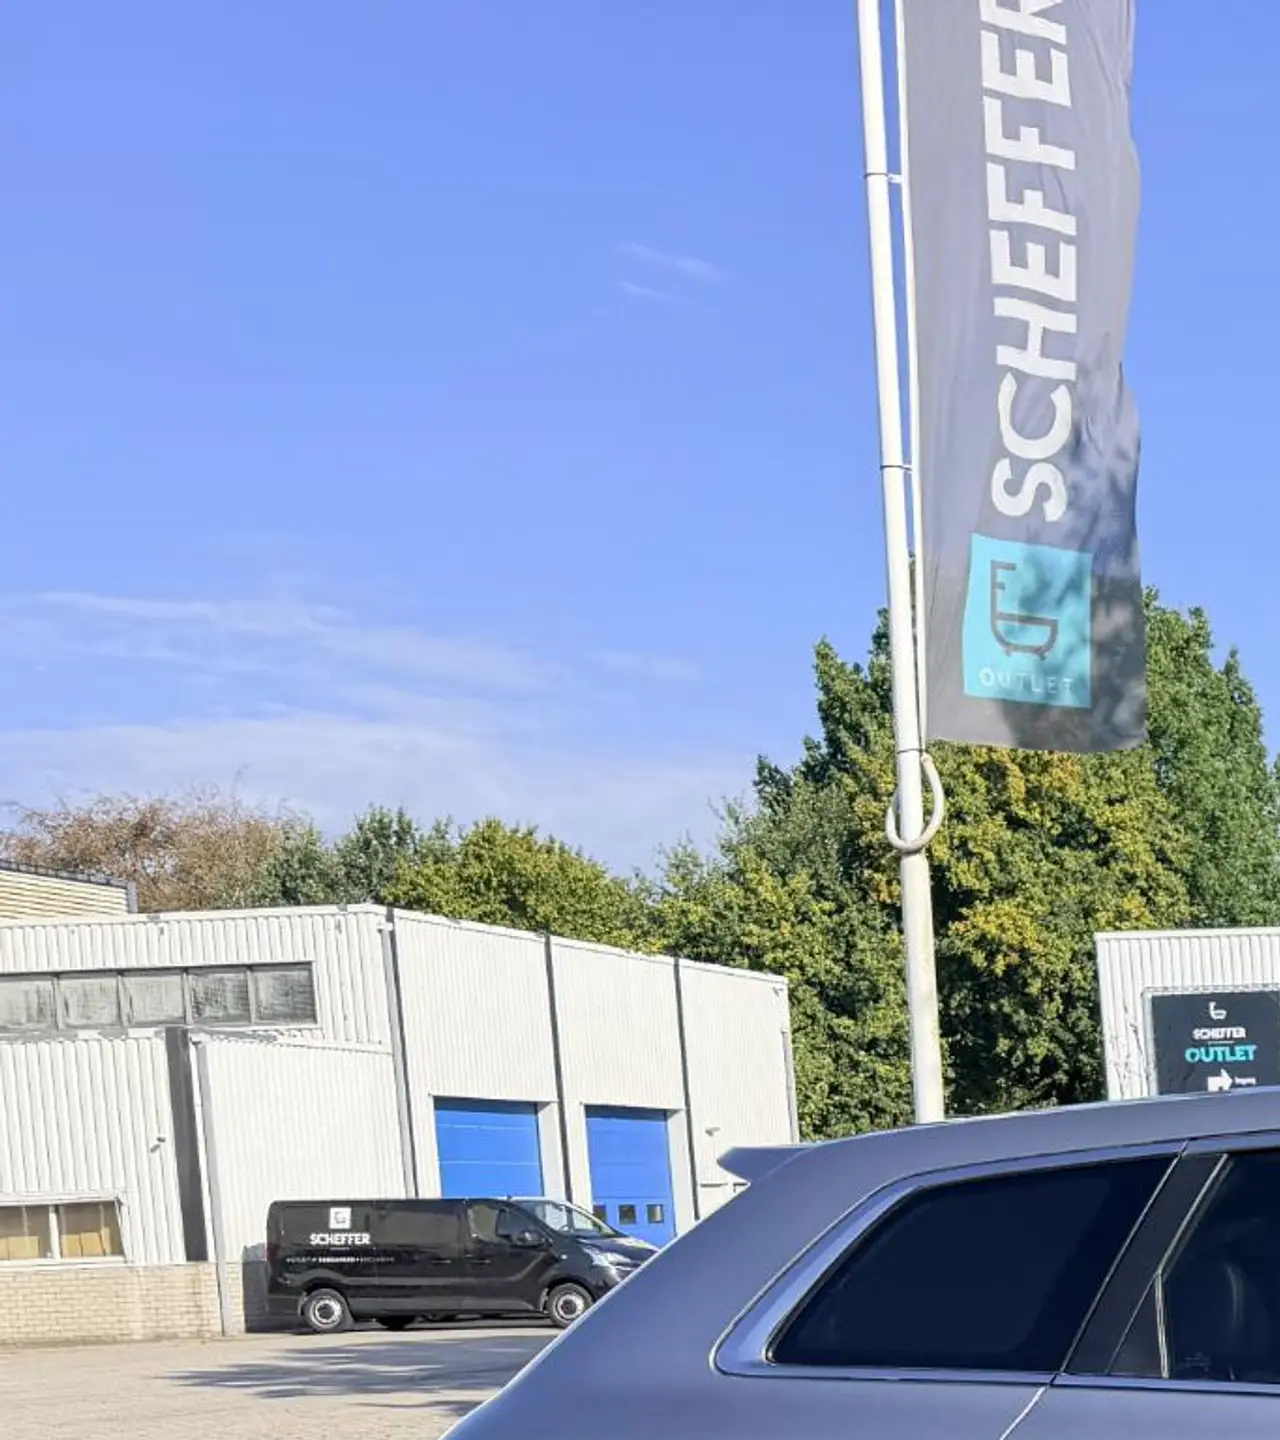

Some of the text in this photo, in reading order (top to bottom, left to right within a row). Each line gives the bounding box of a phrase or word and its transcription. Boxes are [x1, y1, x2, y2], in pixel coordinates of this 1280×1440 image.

[979, 667, 1075, 697] OUTLET
[1185, 1044, 1257, 1062] OUTLET
[309, 1232, 371, 1245] SCHEFFER
